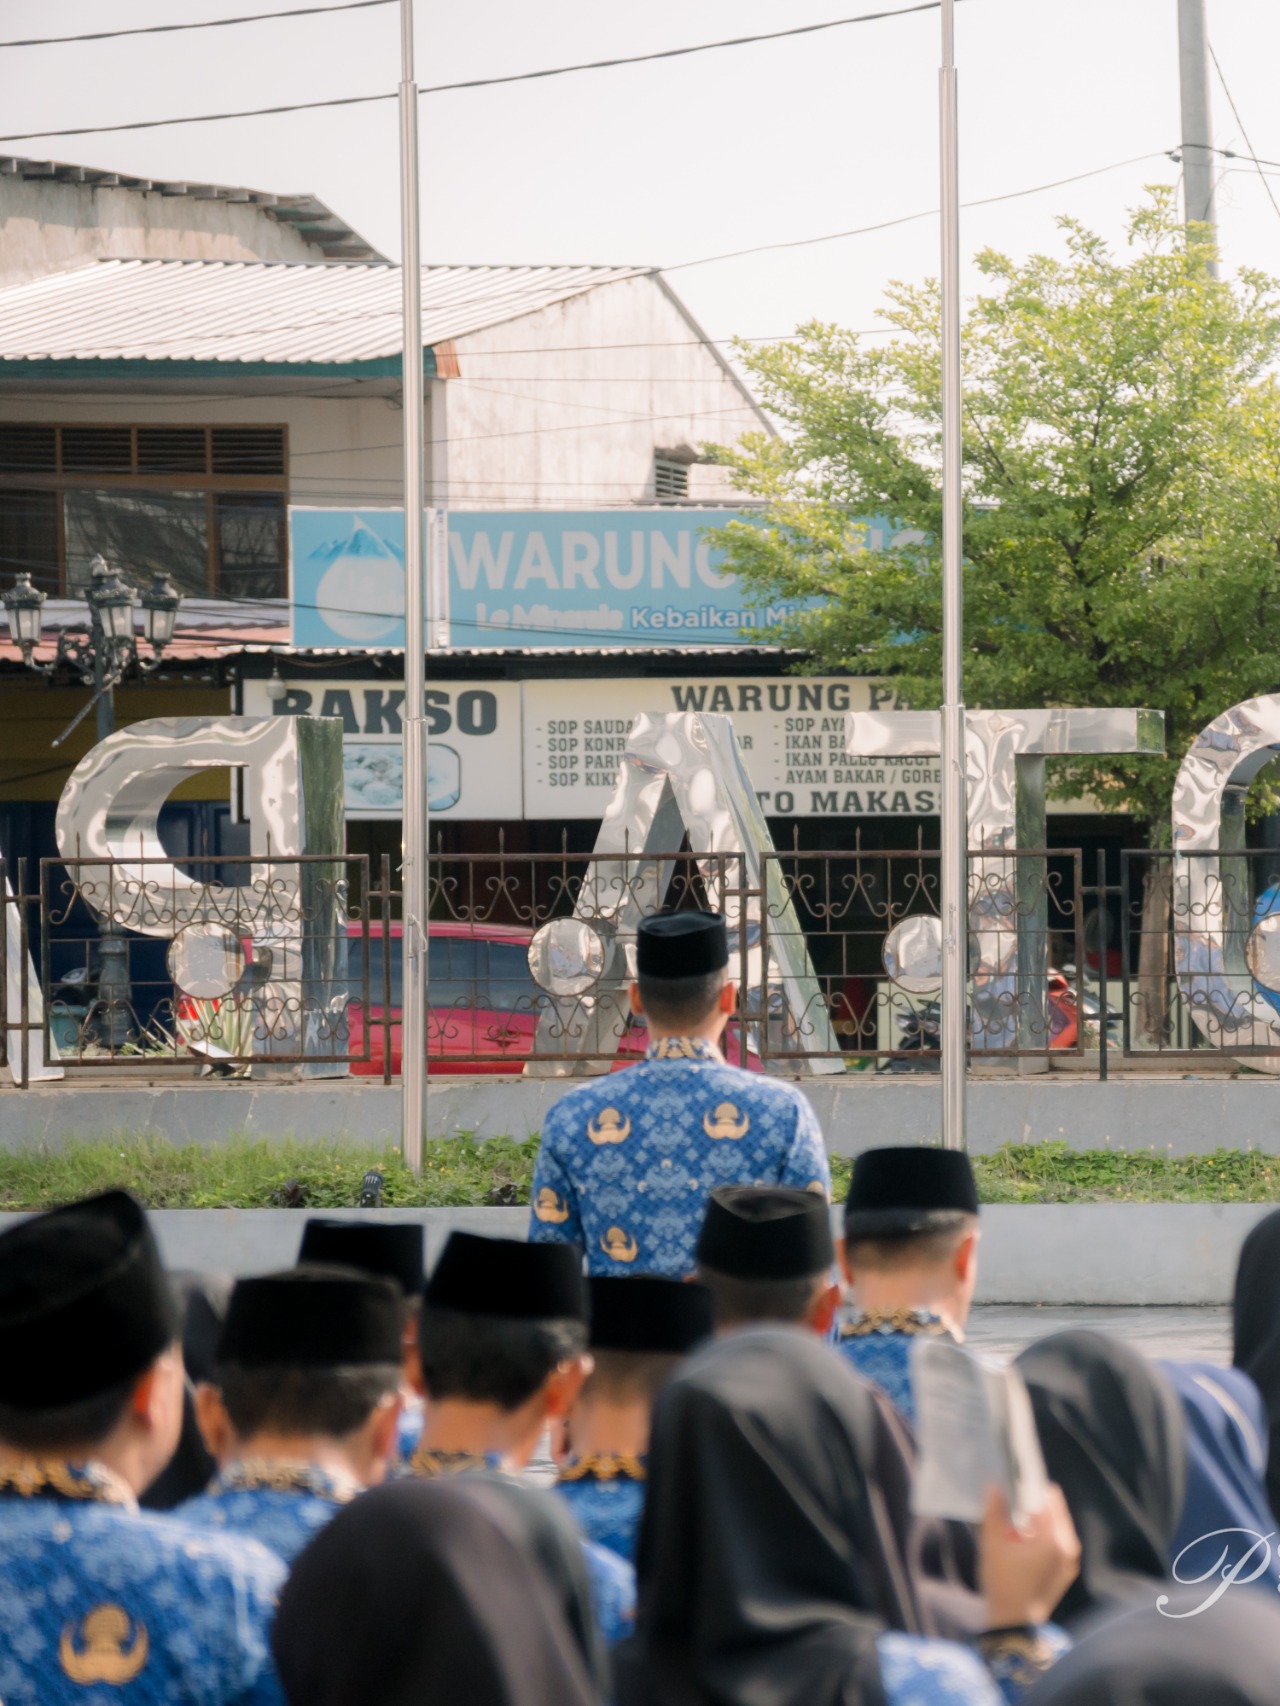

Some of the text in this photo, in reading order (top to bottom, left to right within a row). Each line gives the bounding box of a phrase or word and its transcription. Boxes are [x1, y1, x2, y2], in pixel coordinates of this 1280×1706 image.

[630, 605, 757, 630] Kebaikan
[671, 684, 850, 711] WARUNG
[273, 689, 497, 736] BAKSO
[548, 720, 633, 735] SOP SAUDA
[785, 718, 815, 732] SOP
[548, 737, 626, 752] SOP KONR
[785, 735, 822, 749] IKAN
[549, 754, 578, 769] SOP
[785, 752, 822, 767] IKAN
[549, 772, 579, 787] SOP
[786, 770, 827, 784] AYAM
[834, 769, 885, 784] BAKAR
[902, 769, 941, 784] GORE
[811, 791, 941, 812] MAKAS
